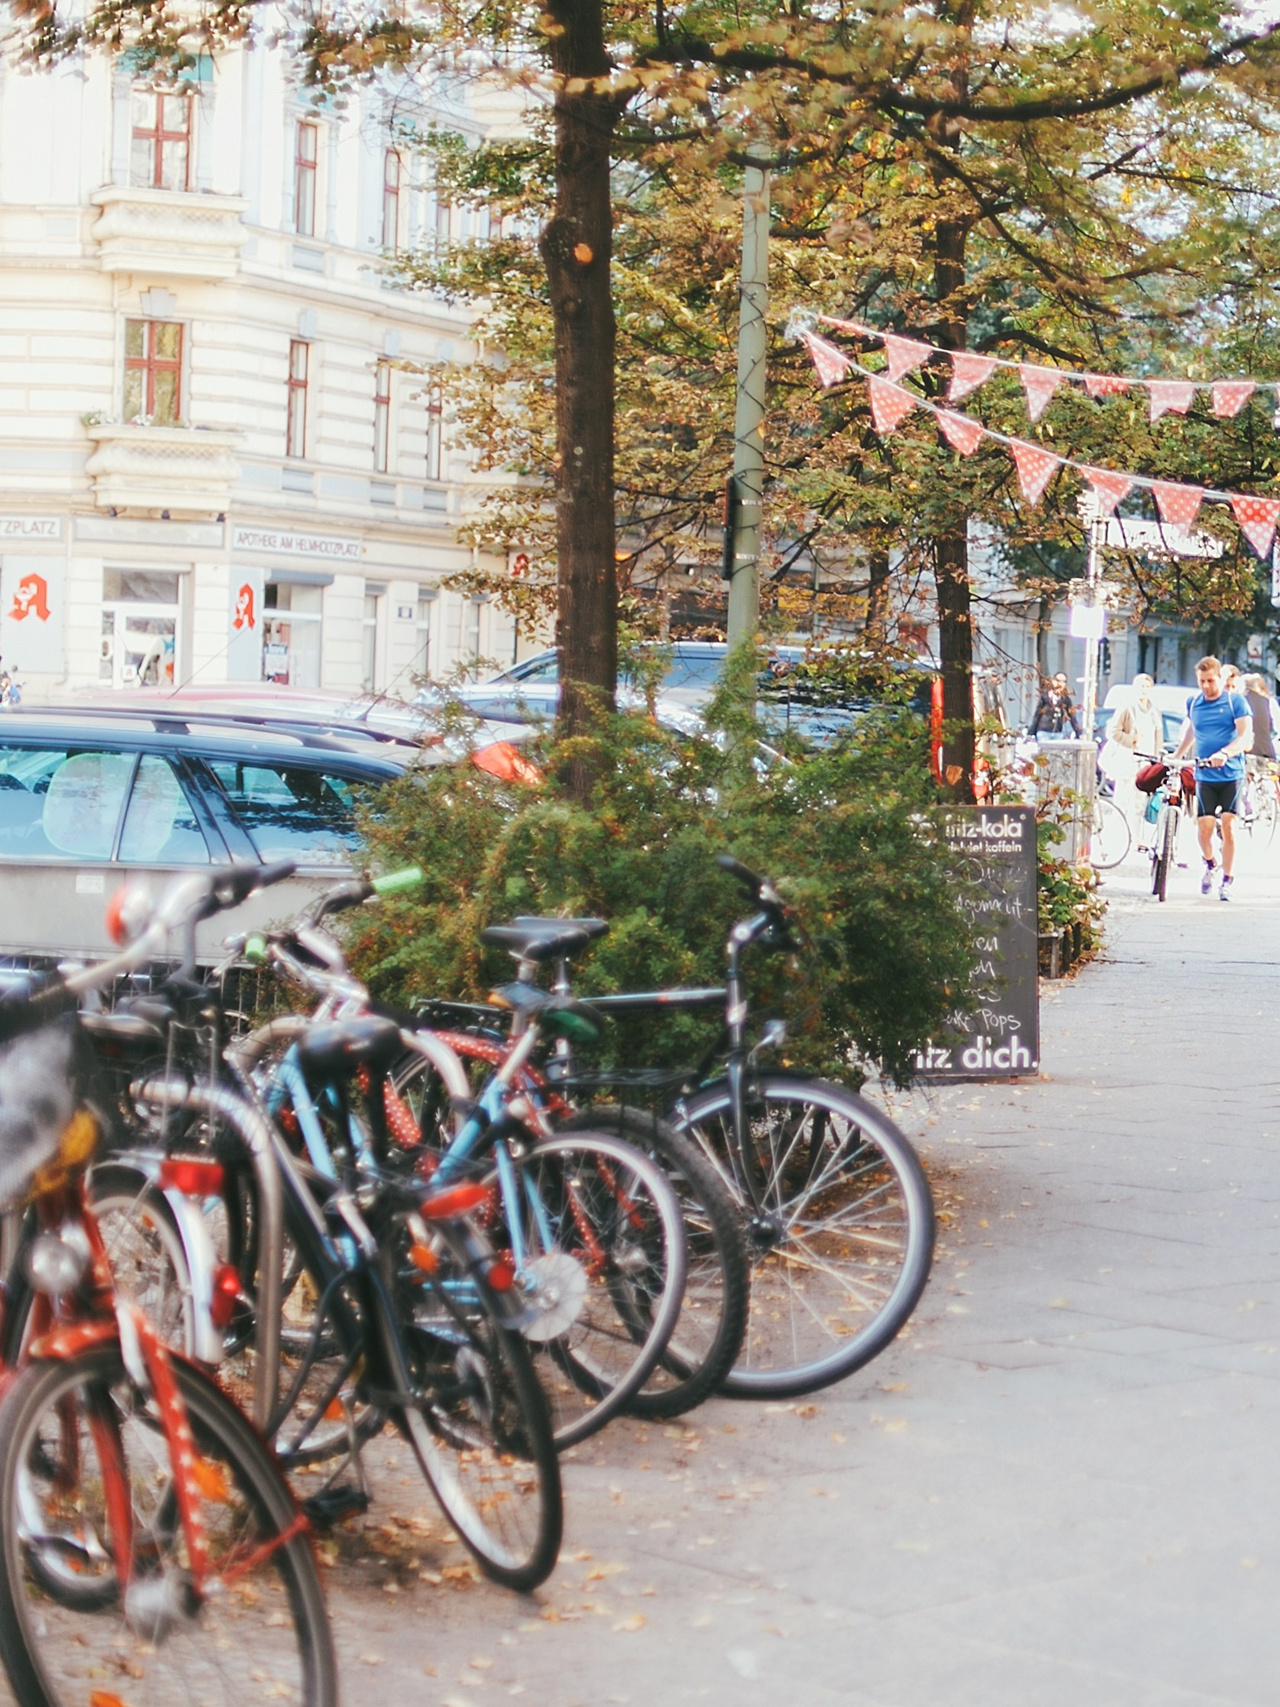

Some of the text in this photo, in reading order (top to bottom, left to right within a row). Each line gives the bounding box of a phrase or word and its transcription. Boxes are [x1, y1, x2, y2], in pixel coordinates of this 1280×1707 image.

[985, 841, 1021, 852] koffein
[976, 1008, 1021, 1035] Pops
[962, 1035, 1039, 1068] dich.
